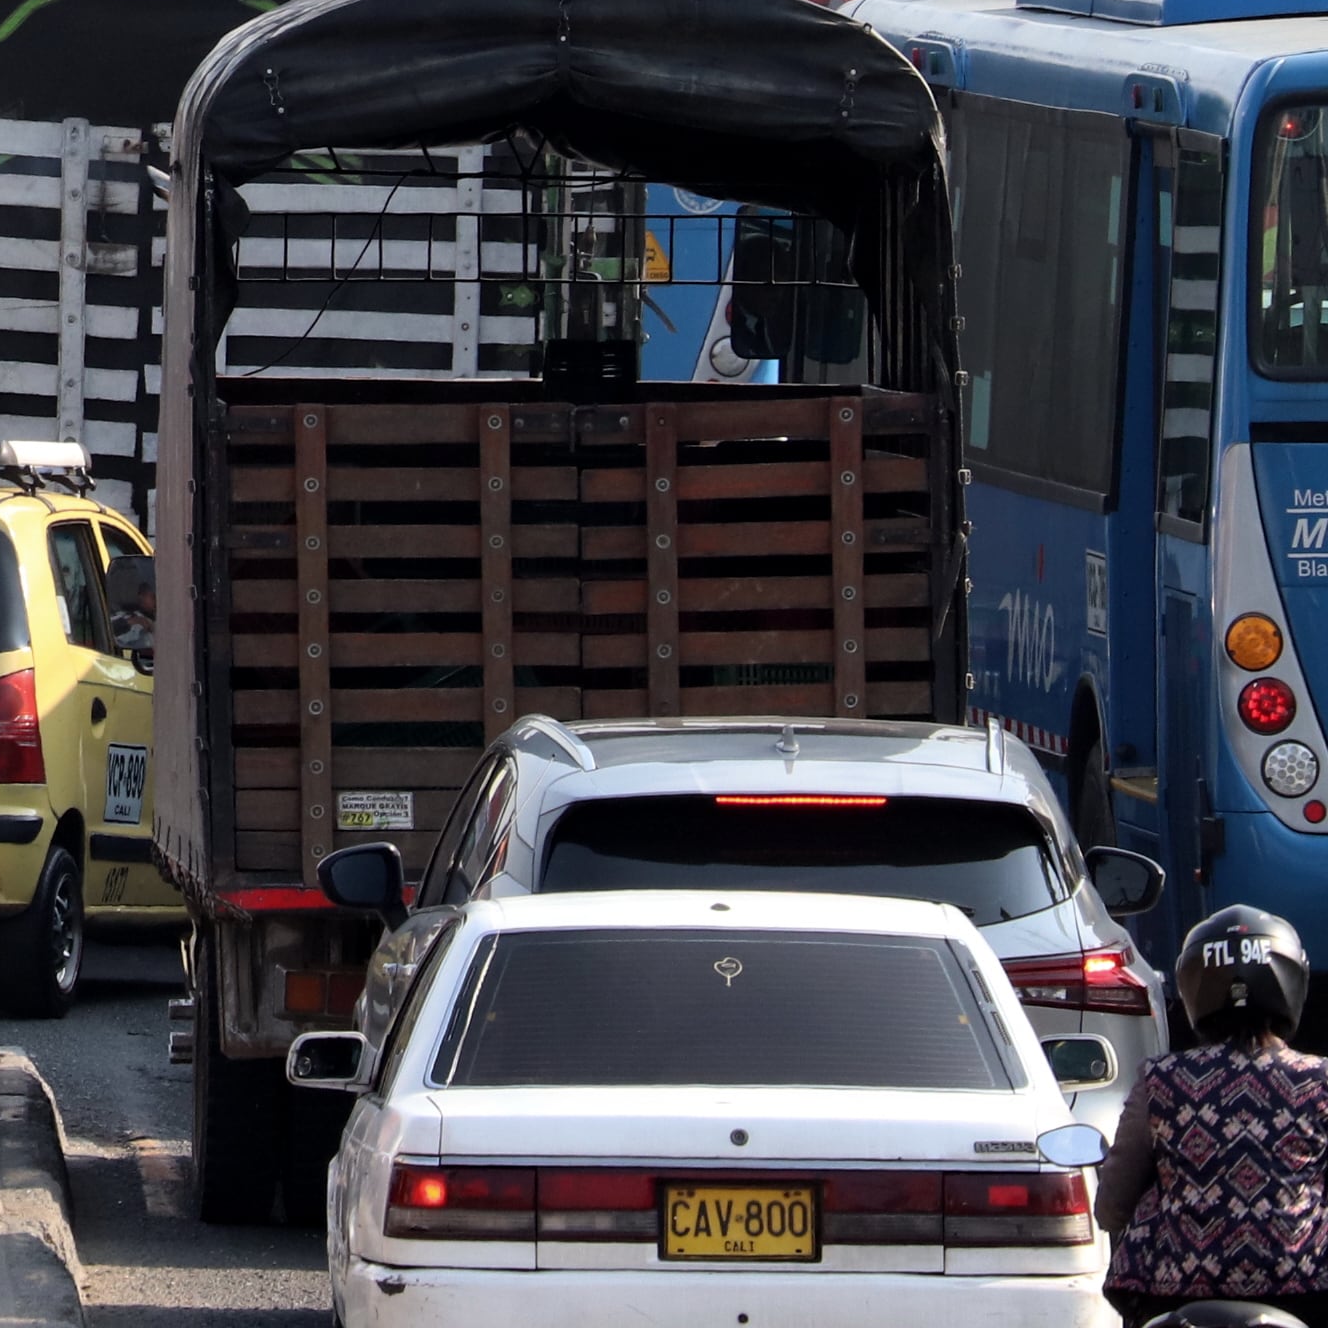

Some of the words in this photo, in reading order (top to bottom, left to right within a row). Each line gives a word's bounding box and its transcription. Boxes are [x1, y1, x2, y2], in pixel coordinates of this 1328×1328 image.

[114, 805, 131, 817] CALI
[1203, 940, 1234, 968] FTL
[1241, 938, 1273, 965] 94E
[724, 1240, 755, 1253] CALI
